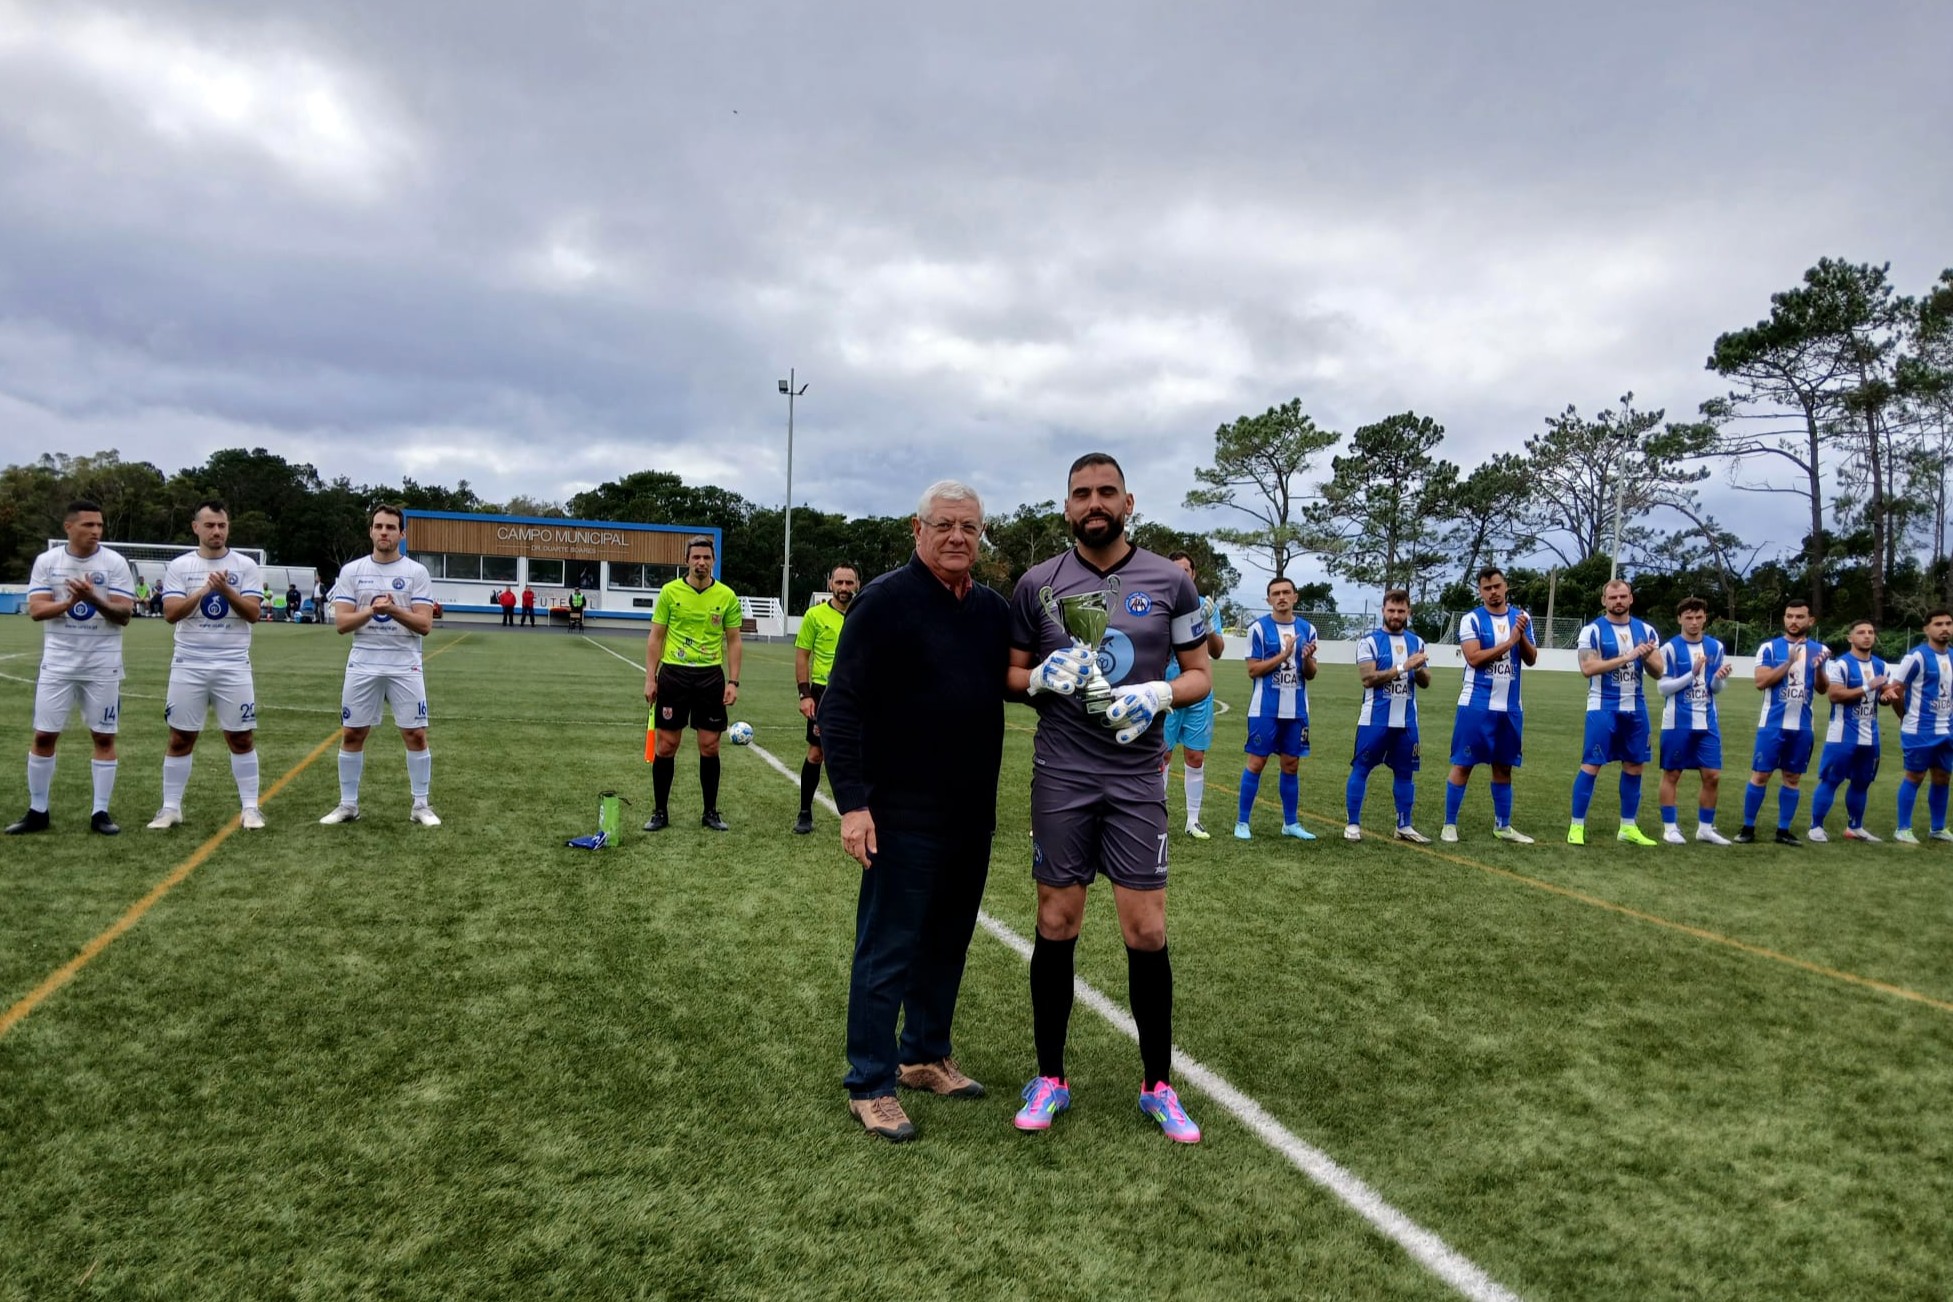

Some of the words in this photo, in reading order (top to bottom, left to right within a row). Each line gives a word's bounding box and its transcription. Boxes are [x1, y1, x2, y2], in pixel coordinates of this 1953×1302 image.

[497, 526, 552, 542] CAMPO
[555, 529, 630, 546] MUNICIPAL
[104, 706, 116, 721] 14
[417, 701, 427, 716] 16
